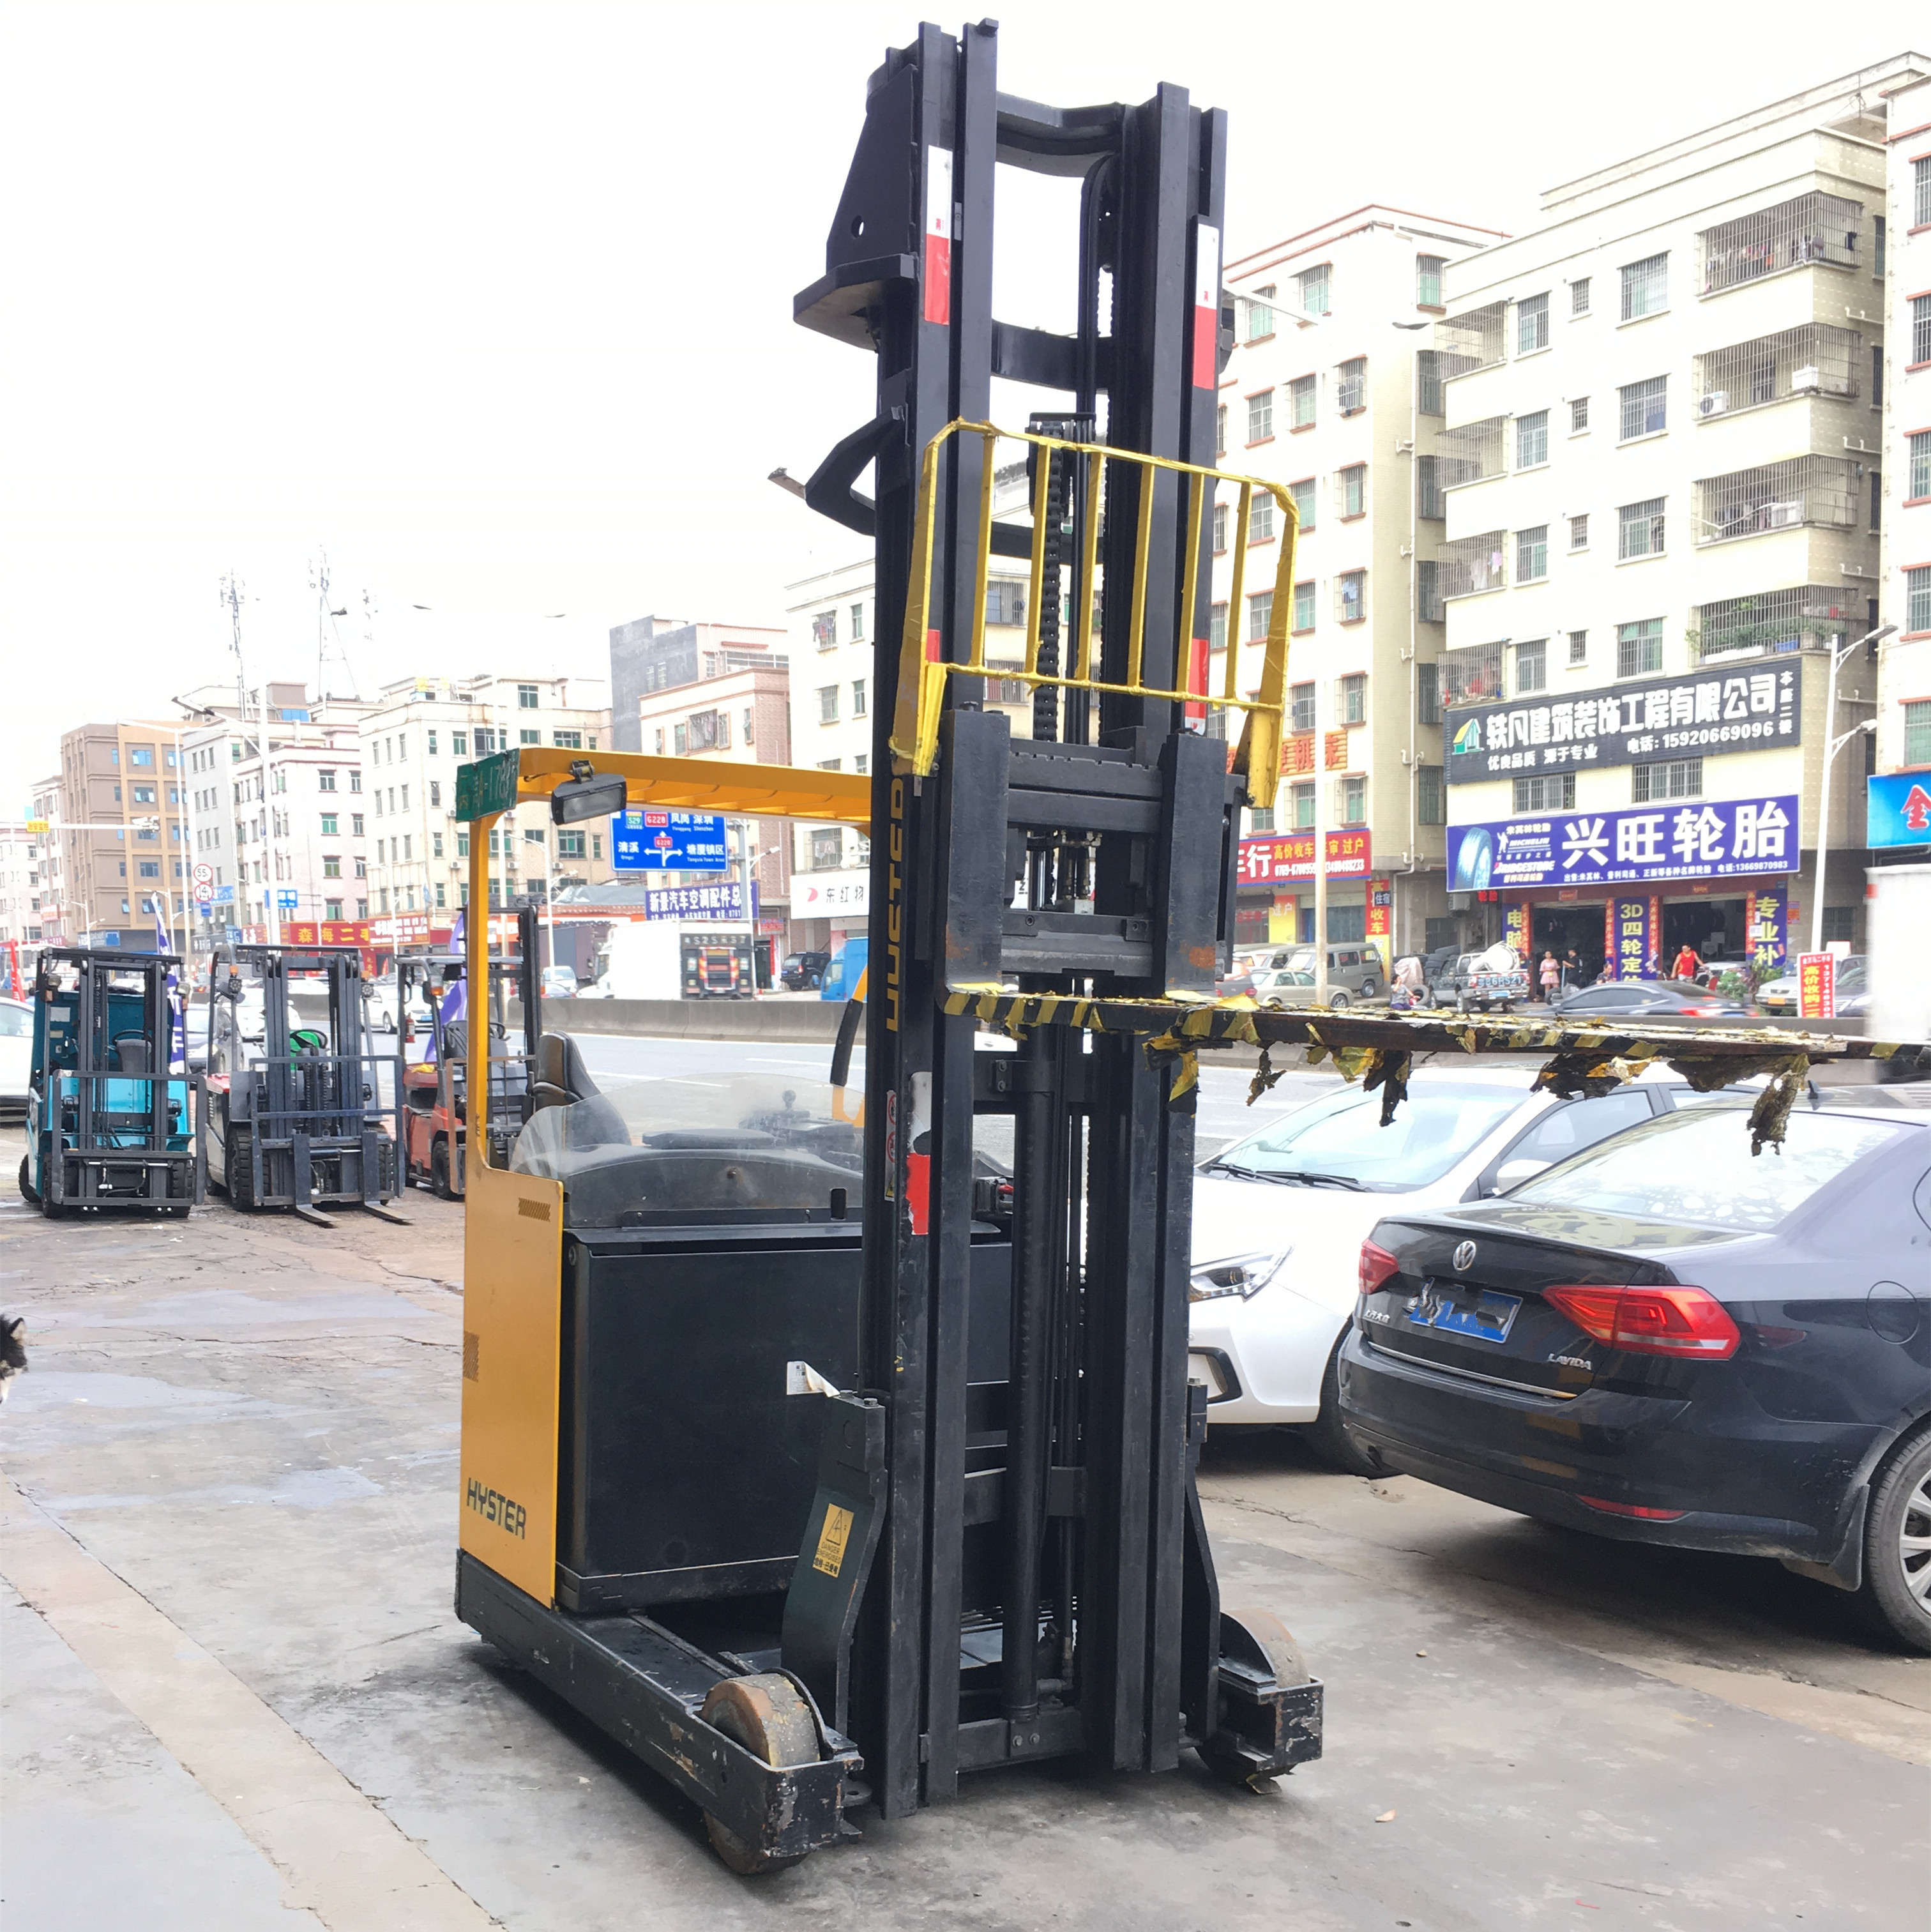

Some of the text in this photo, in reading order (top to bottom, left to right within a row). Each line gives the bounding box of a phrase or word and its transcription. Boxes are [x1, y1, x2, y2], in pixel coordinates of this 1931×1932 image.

[1488, 743, 1598, 771] 优良品质 源于专业
[1901, 784, 1931, 830] 金
[671, 812, 714, 825] 凤岗 深圳
[1509, 837, 1550, 847] MICHELIN
[1562, 801, 1790, 869] 兴旺轮胎
[617, 841, 639, 853] 清溪
[686, 844, 725, 855] 塘厦镇区
[1273, 841, 1314, 860] 高价收车
[1343, 837, 1364, 855] 过户
[1492, 860, 1556, 874] BRIDGESTONE
[650, 885, 752, 912] 新景汽车空调配件总
[826, 886, 864, 903] 东红物
[1375, 893, 1390, 906] 住宿
[1370, 881, 1384, 934] 高收车
[1754, 896, 1780, 966] 专业补
[1548, 1353, 1592, 1371] LAVIDA
[466, 1477, 526, 1540] HYSTER
